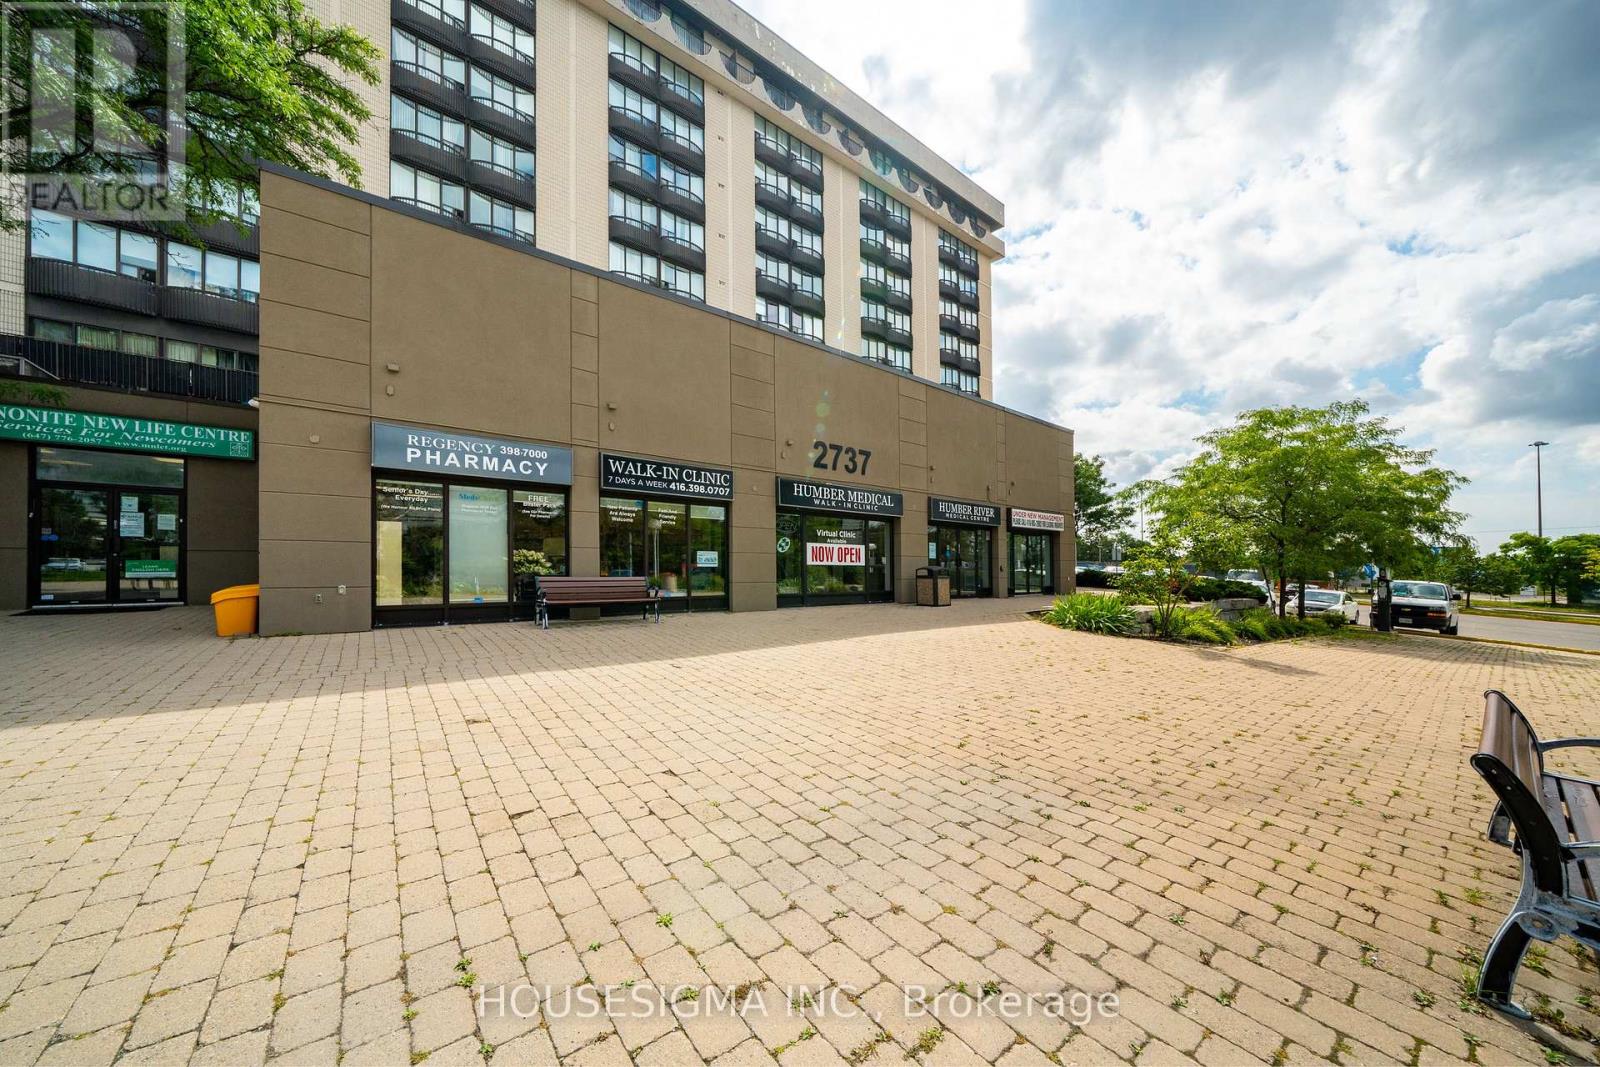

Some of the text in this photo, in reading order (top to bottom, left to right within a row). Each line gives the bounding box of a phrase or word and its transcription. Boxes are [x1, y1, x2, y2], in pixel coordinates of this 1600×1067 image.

[80, 428, 115, 439] For
[120, 432, 216, 448] Newcomers
[83, 415, 129, 431] NEW
[134, 421, 176, 436] LIFE
[181, 426, 250, 443] CENTRE
[407, 434, 496, 454] REGENCY
[406, 447, 548, 476] PHARMACY
[813, 441, 872, 476] 2737
[608, 458, 730, 487] WALK-IN CLINIC
[382, 486, 413, 494] Senior's
[615, 476, 636, 486] DAYS
[646, 480, 668, 489] WEEK
[669, 482, 730, 496] 416.398.0707
[793, 483, 894, 507] HUMBER MEDICAL
[395, 494, 429, 504] Everyday
[813, 498, 836, 507] WALK
[939, 501, 995, 518] HUMBER RIVER
[816, 528, 857, 539] Virtual Clinic
[811, 545, 861, 563] NOW OPEN
